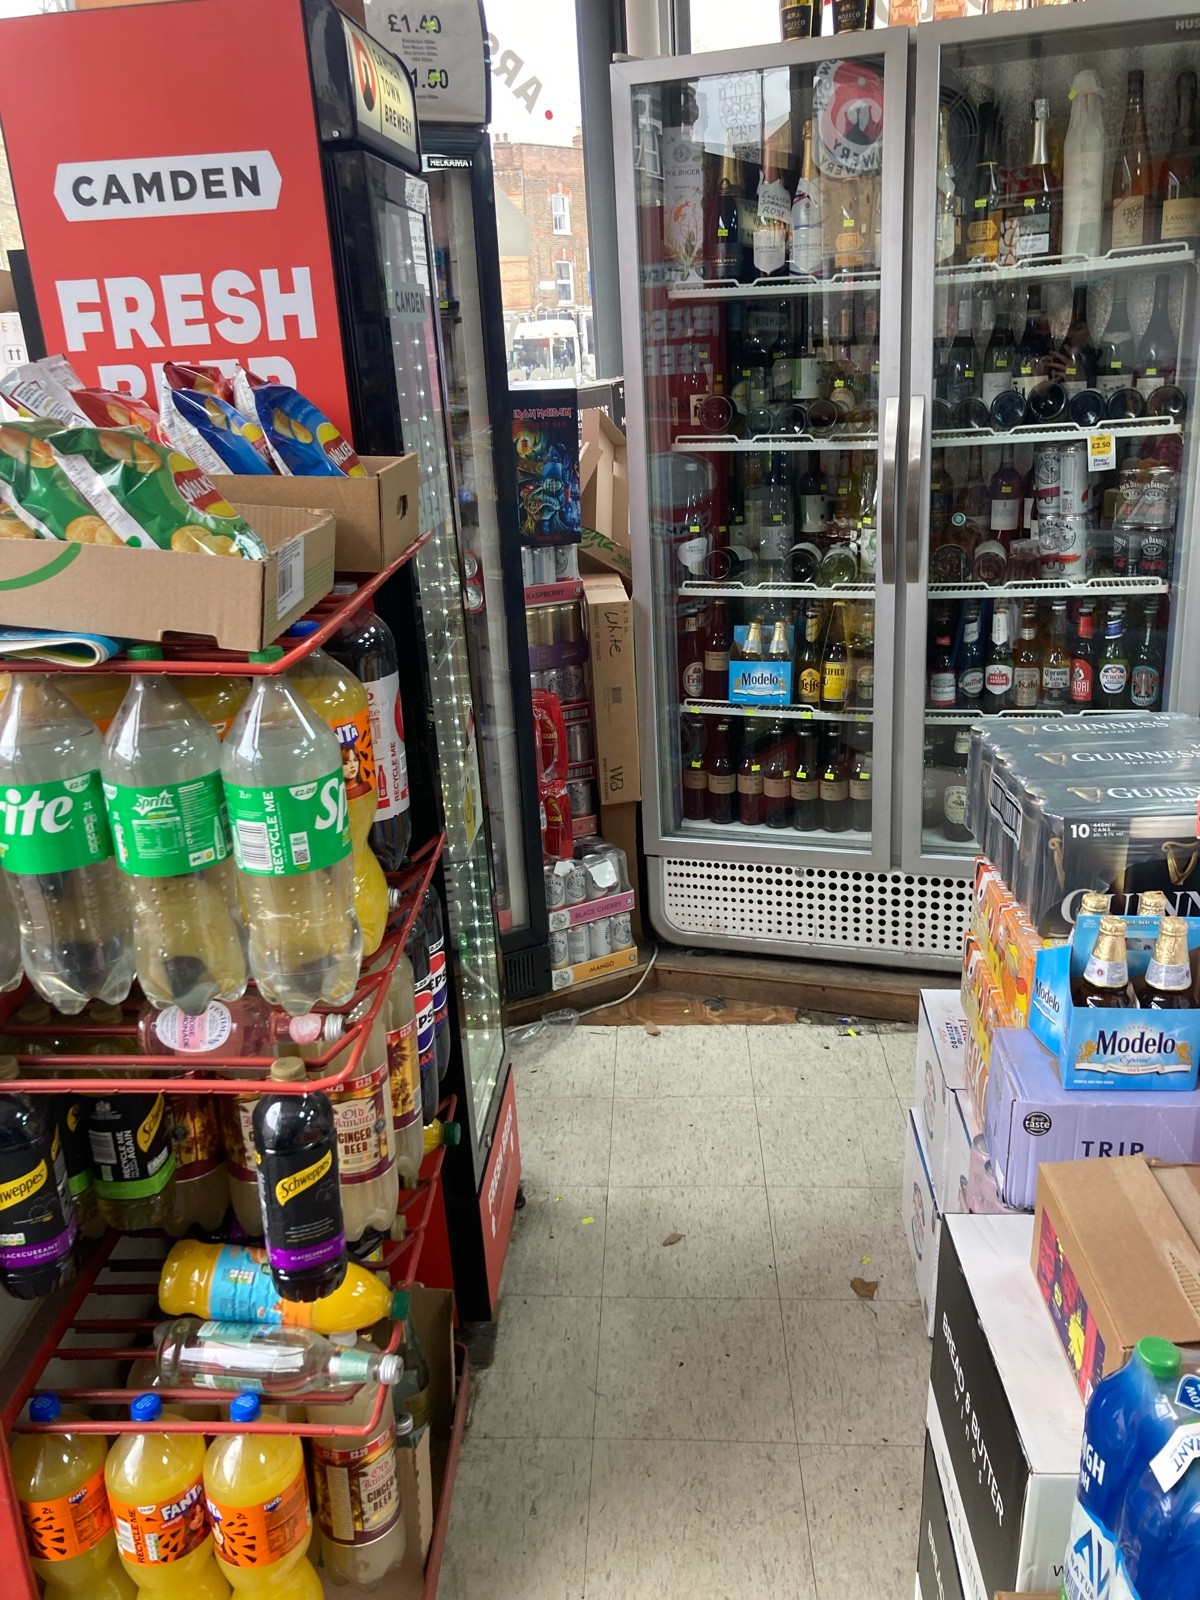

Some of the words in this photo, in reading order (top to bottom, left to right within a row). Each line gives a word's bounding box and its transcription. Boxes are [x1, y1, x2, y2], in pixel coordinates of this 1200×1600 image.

[384, 103, 413, 137] BREWERY
[72, 165, 262, 207] CAMDEN
[55, 266, 318, 353] FRESH
[394, 290, 426, 314] CAMDEN
[512, 408, 536, 420] IRON
[536, 407, 573, 419] MAIDEN
[1091, 441, 1111, 449] £2.50
[526, 588, 565, 600] RASPBERRY
[603, 610, 624, 658] White
[741, 672, 779, 686] Modelo
[801, 677, 820, 693] Leffe
[1015, 680, 1038, 689] Asahi
[1041, 720, 1170, 732] GUINNESS
[135, 793, 174, 811] Sprite
[262, 791, 276, 812] ME
[1070, 823, 1090, 839] 10
[266, 815, 286, 875] RECYCLE
[575, 908, 597, 920] BLACK
[599, 902, 622, 914] CHERRY
[589, 960, 615, 973] MANGO
[1035, 978, 1060, 1013] Modelo
[1095, 1029, 1176, 1056] Modelo
[342, 1107, 365, 1120] Old
[1025, 1119, 1051, 1129] taste
[123, 1130, 136, 1160] AGAIN
[337, 1127, 372, 1145] GINGER
[344, 1141, 369, 1155] BEER
[1081, 1140, 1146, 1158] TRIP
[281, 1158, 330, 1199] Schweppes
[942, 1311, 965, 1393] BREAD
[971, 1409, 1004, 1527] BUTTER
[366, 1476, 395, 1504] GINGER
[41, 1507, 54, 1515] 2L
[160, 1484, 203, 1522] FANTA
[372, 1493, 392, 1512] BEER
[127, 1508, 138, 1523] ME
[236, 1512, 248, 1520] 2L
[131, 1523, 145, 1564] RECYCLE
